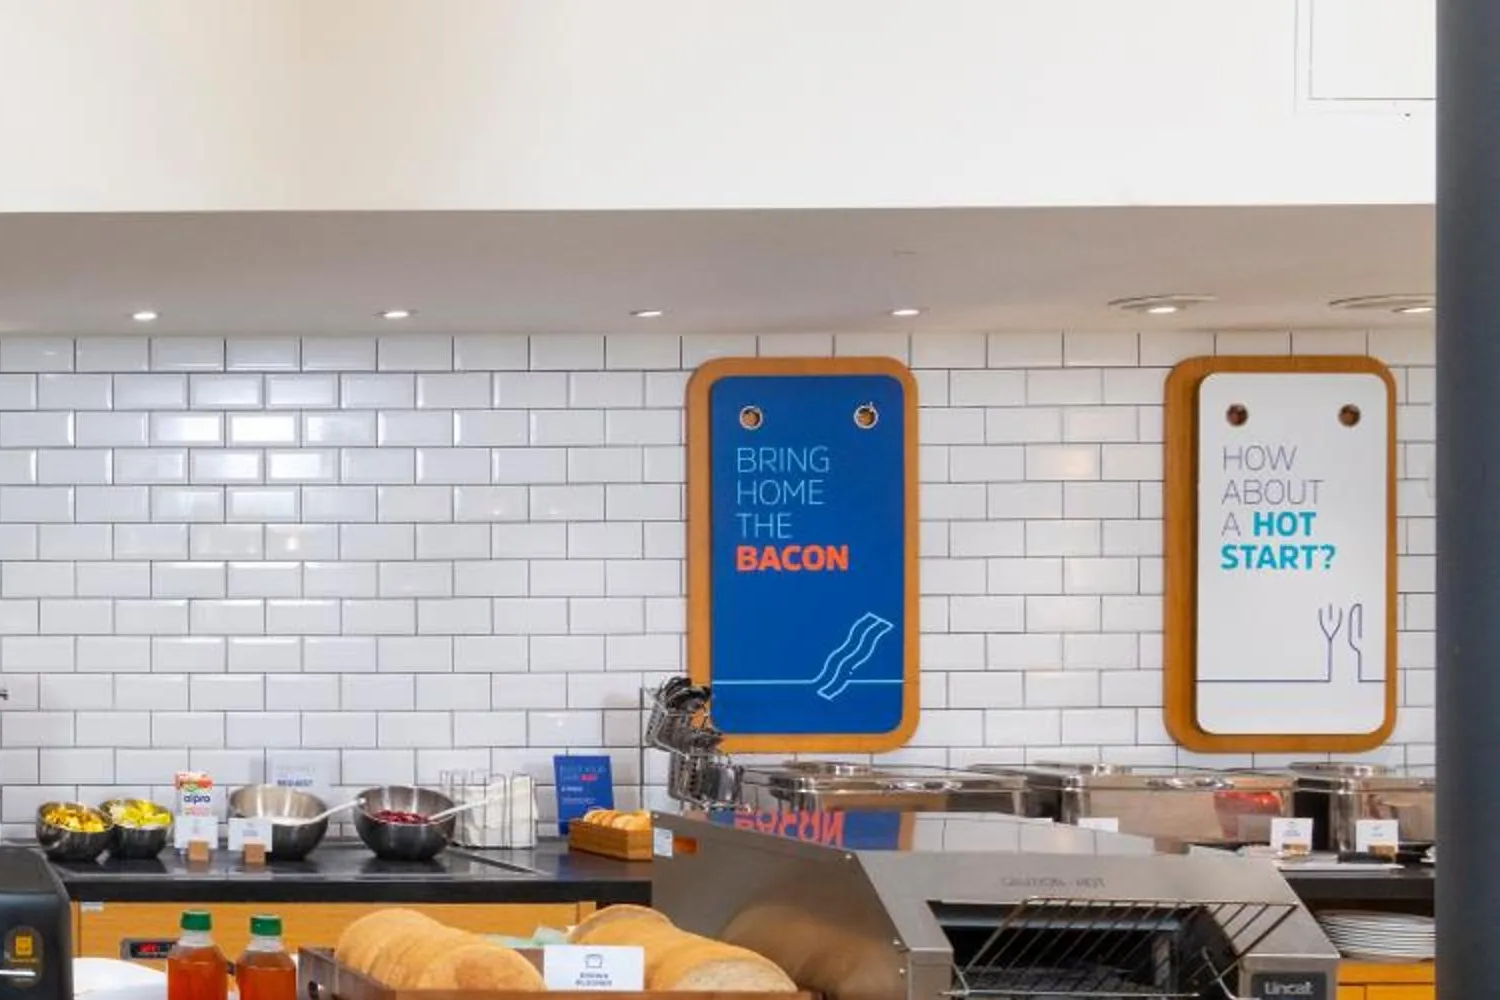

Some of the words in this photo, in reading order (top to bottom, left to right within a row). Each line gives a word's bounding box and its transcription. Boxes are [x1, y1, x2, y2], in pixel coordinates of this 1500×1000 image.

[736, 446, 830, 473] BRING
[1222, 445, 1298, 471] HOW
[736, 479, 826, 506] HOME
[1221, 479, 1325, 506] ABOUT
[736, 512, 793, 539] THE
[1221, 512, 1242, 537] A
[1252, 511, 1317, 537] HOT
[736, 544, 849, 572] BACON
[1220, 544, 1337, 571] START?
[183, 794, 211, 804] alpro
